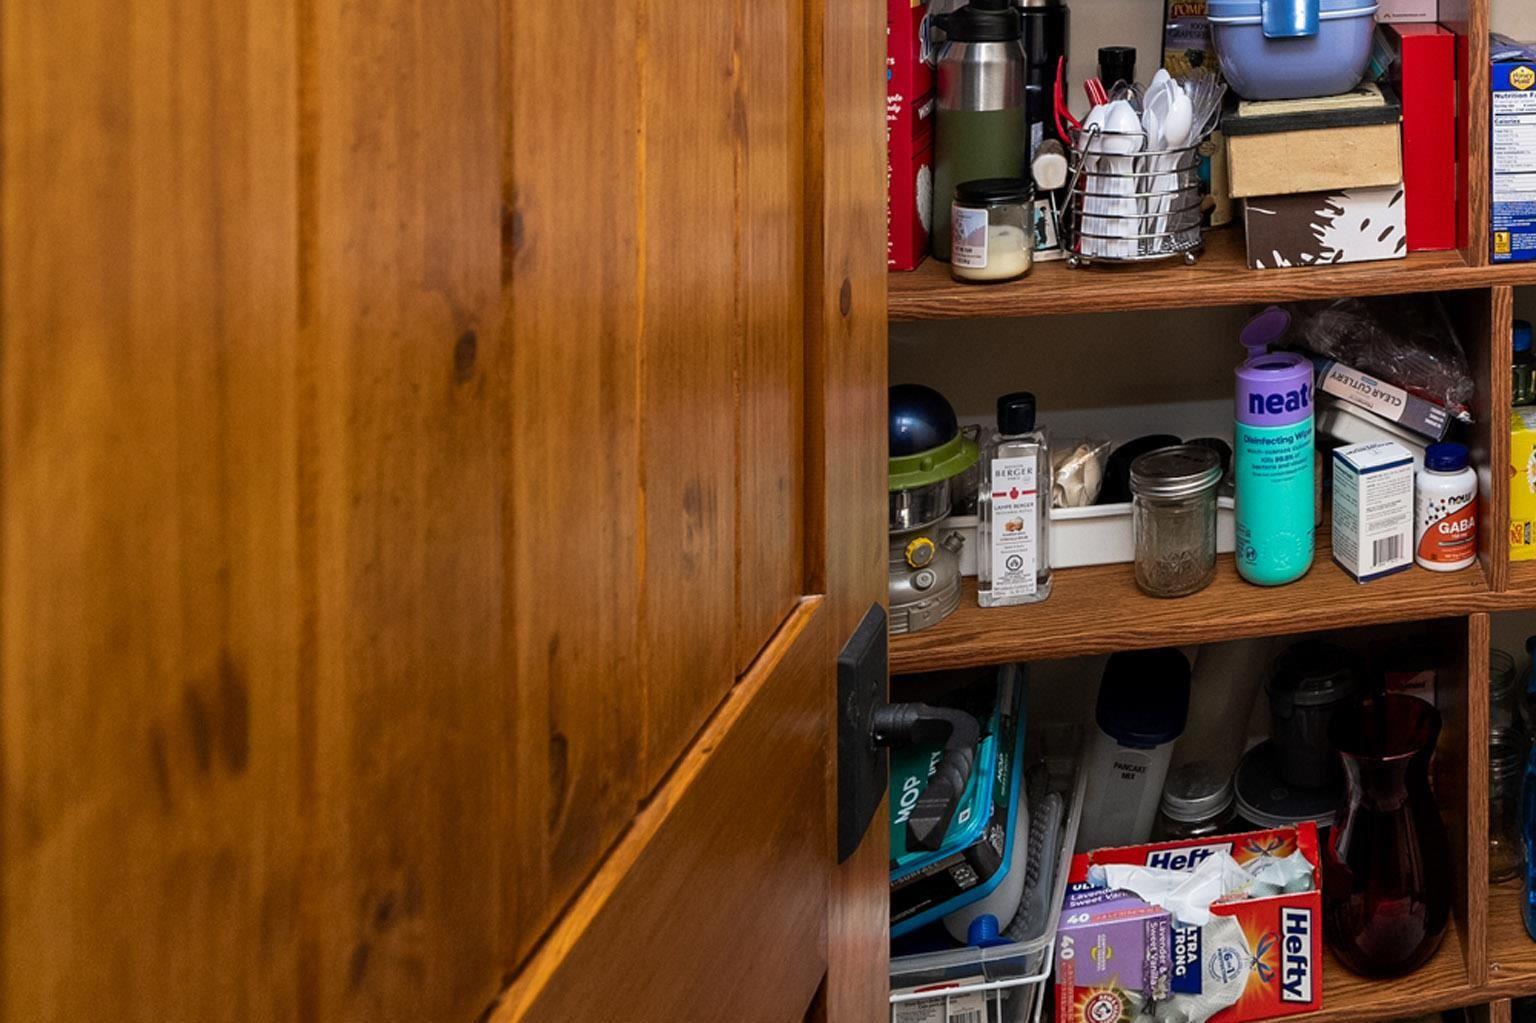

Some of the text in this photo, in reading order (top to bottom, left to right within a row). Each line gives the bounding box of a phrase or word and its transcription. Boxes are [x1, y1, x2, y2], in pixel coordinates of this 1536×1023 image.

[1330, 371, 1402, 407] CLEAR CUTLERY
[1243, 434, 1294, 446] Disinfecting
[995, 467, 1033, 477] BERGER
[1438, 516, 1476, 534] GABA
[1113, 761, 1148, 773] PANCAKE
[1121, 772, 1136, 780] MIX
[894, 775, 921, 825] MOP
[1069, 895, 1104, 908] Sweet
[1066, 912, 1091, 925] 40
[1149, 921, 1159, 953] Sweet
[1158, 919, 1170, 965] Lavender
[1060, 935, 1076, 961] 40
[1285, 912, 1309, 998] Hefty
